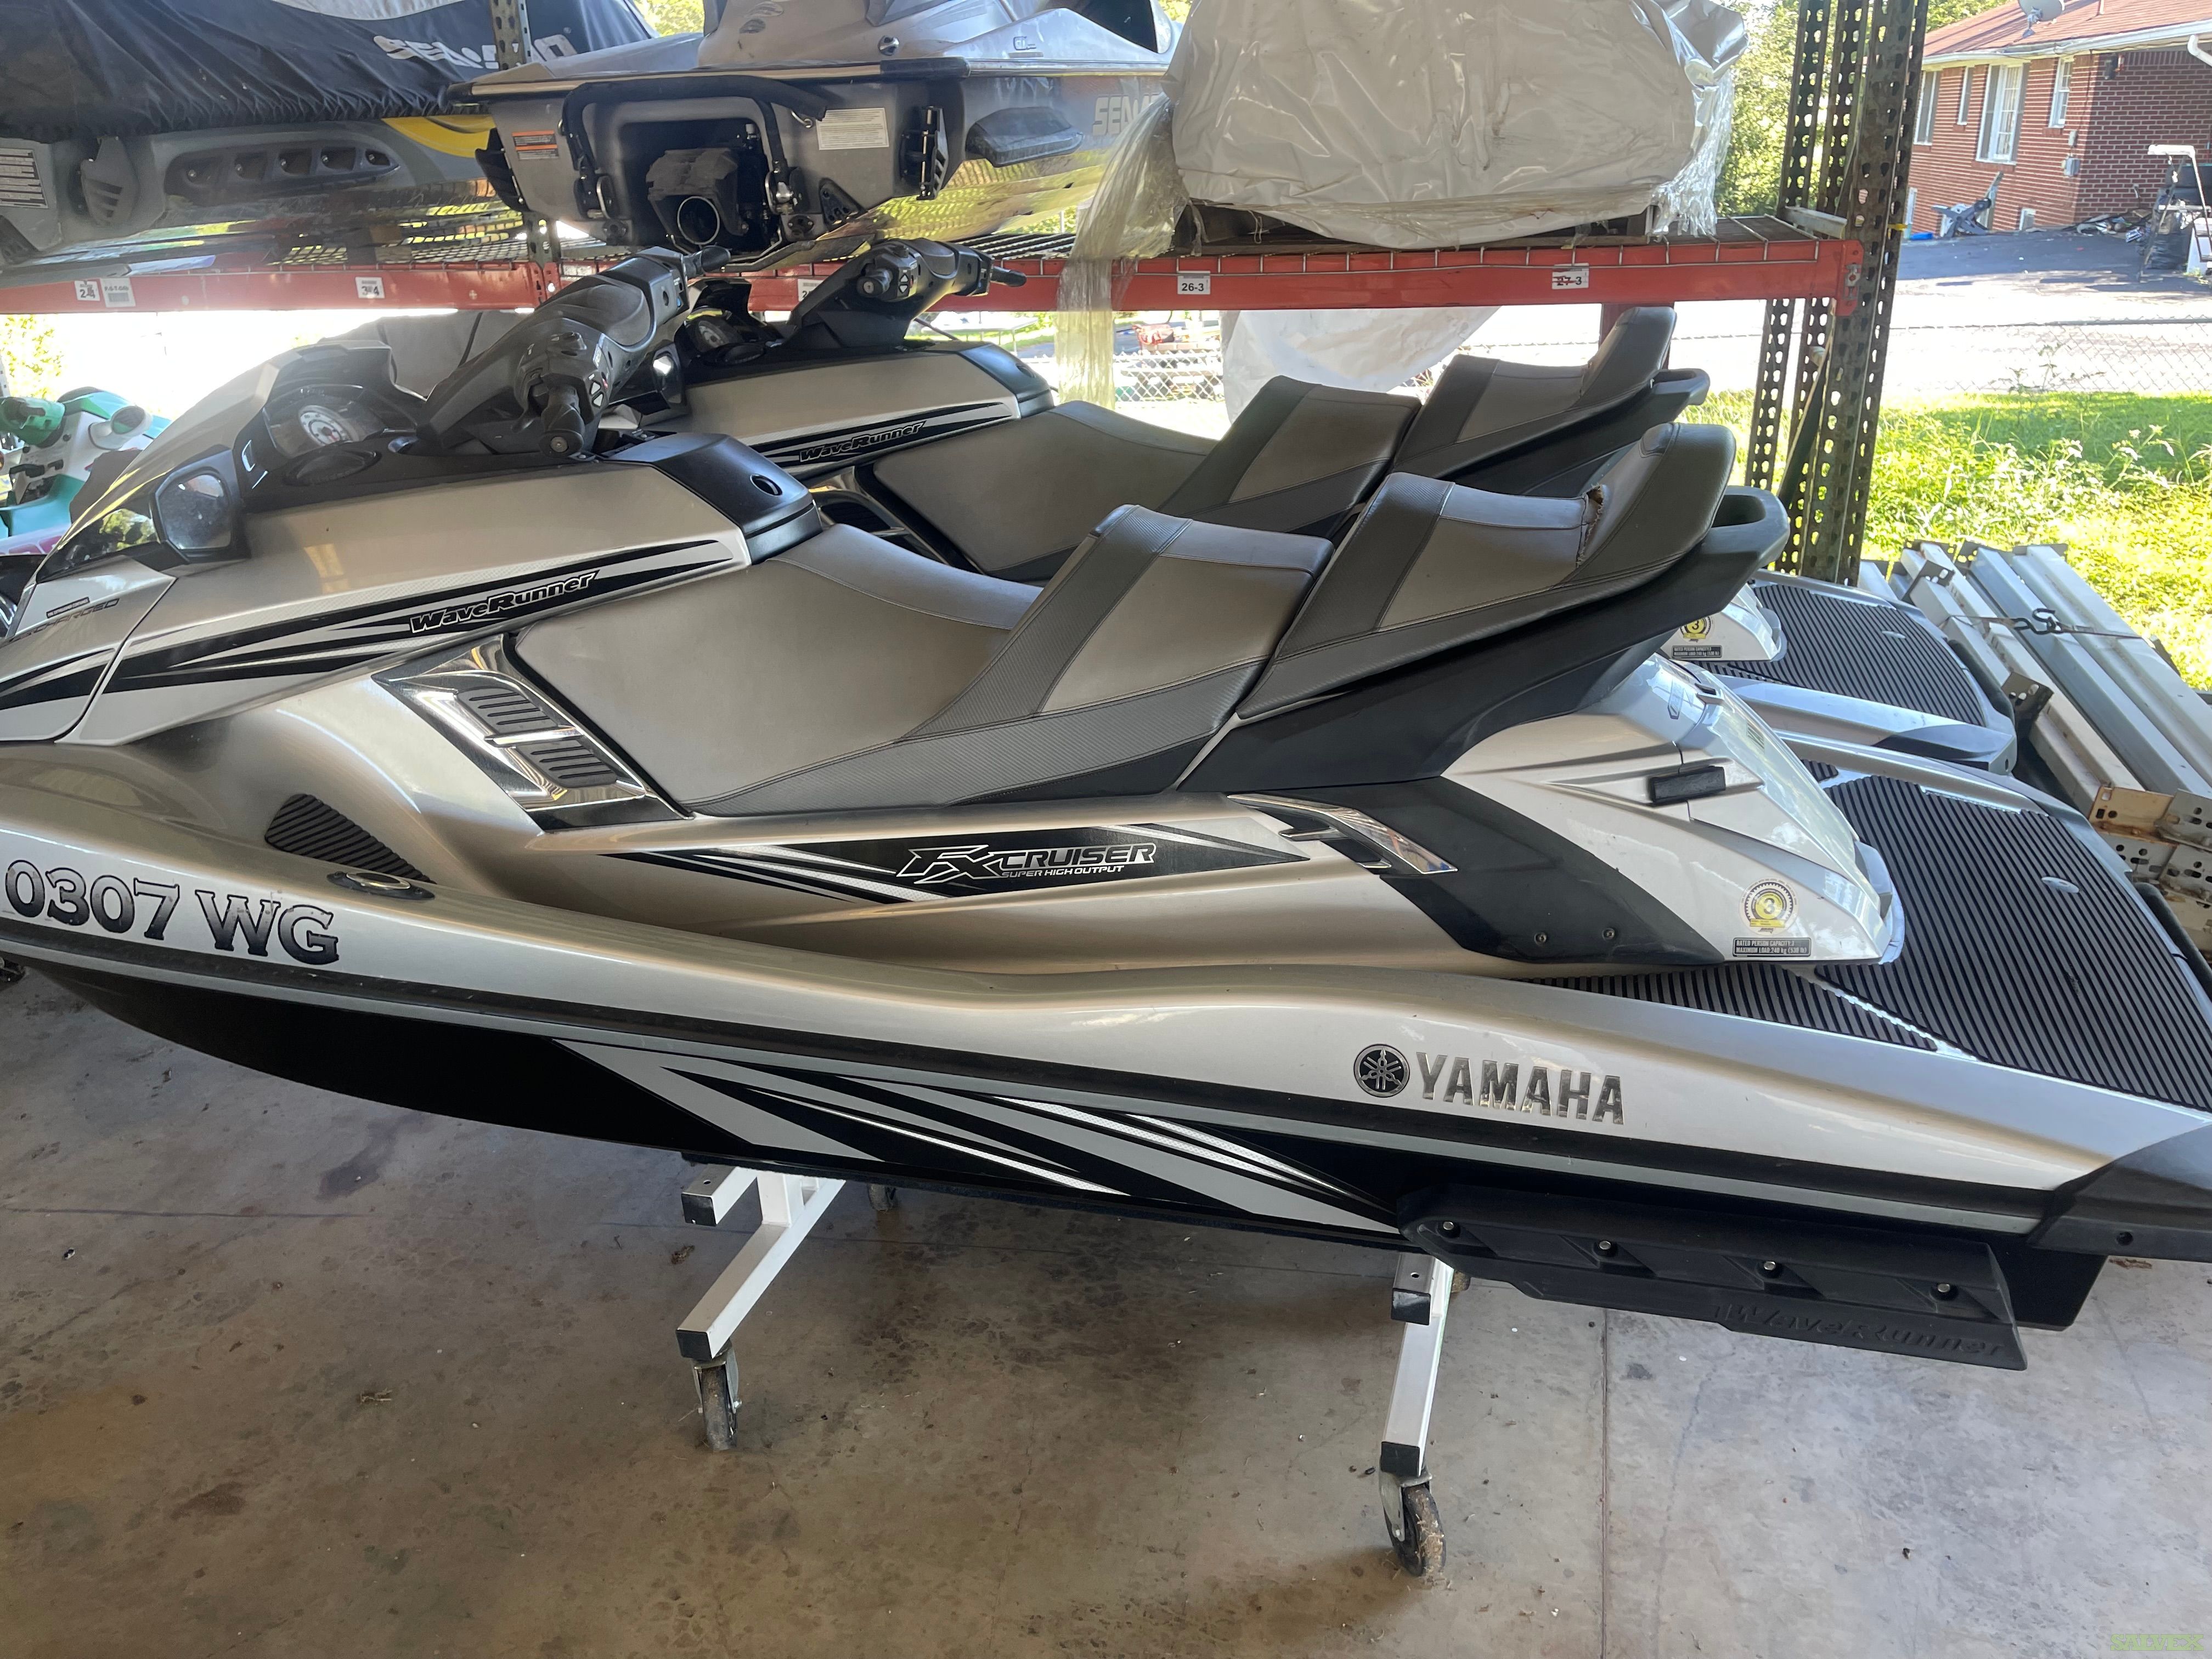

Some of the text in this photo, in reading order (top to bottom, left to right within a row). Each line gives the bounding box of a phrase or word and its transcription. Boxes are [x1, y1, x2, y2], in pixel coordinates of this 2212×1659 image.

[1181, 283, 1204, 291] 26-3
[800, 421, 926, 462] WaveRunner
[409, 571, 599, 634] WaveRunner
[896, 844, 1155, 884] FX CRUISER
[1001, 865, 1125, 878] SUPER HIGH OUTPUT
[5, 860, 339, 965] 0307 WG
[1764, 898, 1775, 915] 3
[1415, 1051, 1625, 1125] YAMAHA
